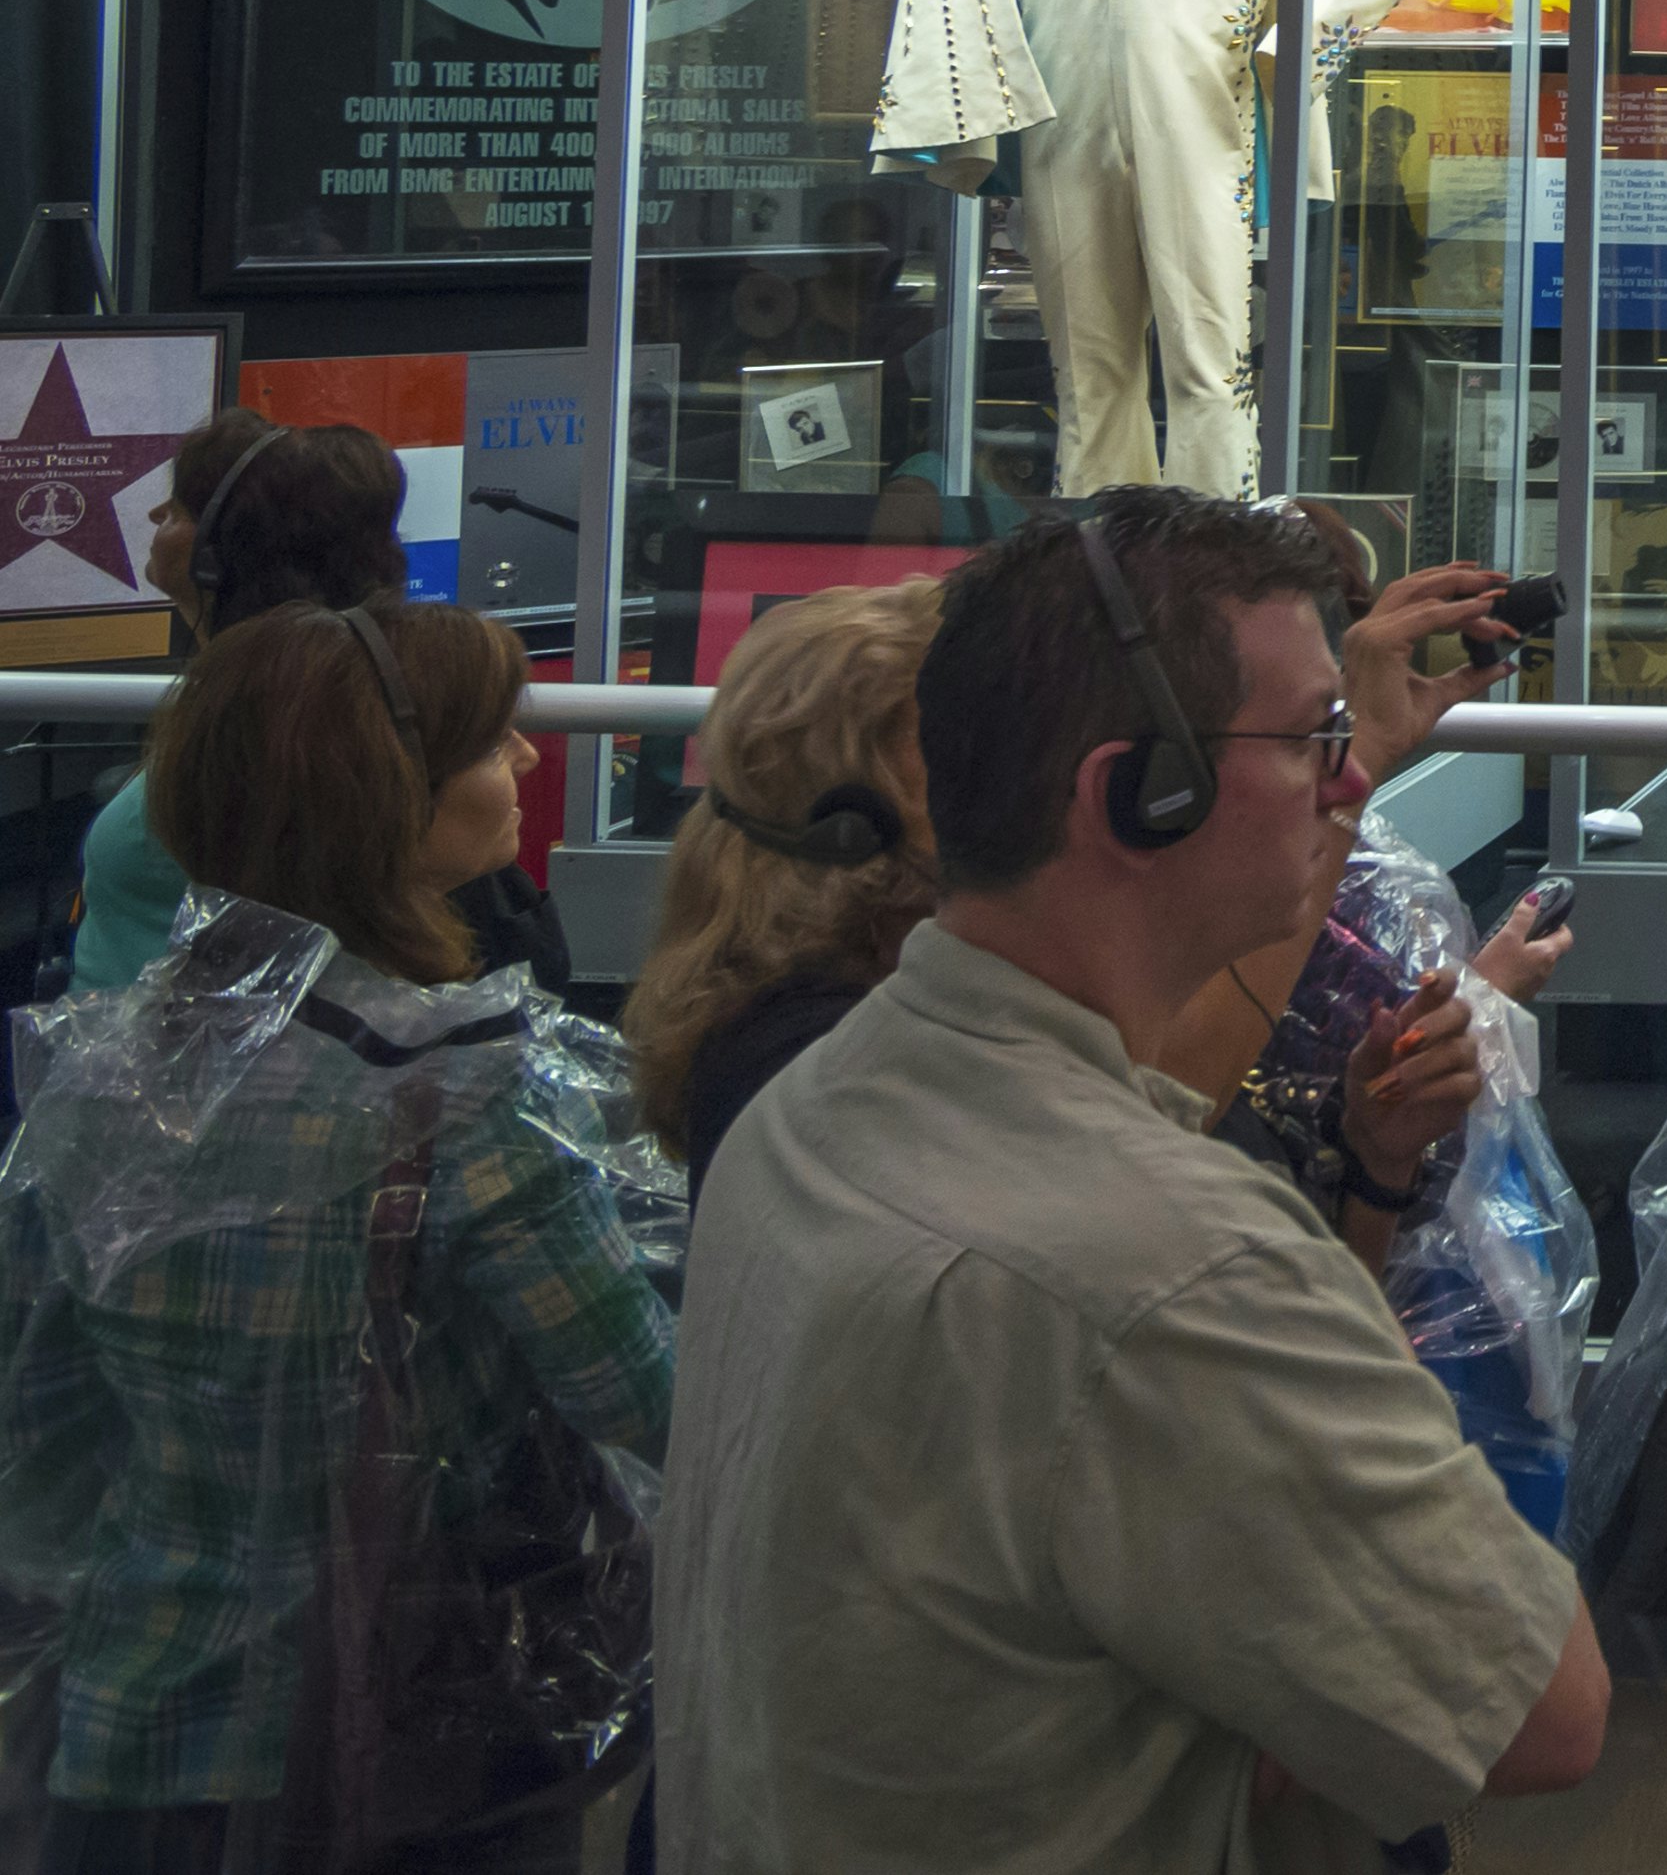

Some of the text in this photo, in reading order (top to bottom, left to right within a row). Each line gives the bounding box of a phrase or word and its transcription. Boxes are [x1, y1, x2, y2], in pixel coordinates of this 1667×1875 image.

[392, 61, 421, 87] TO
[433, 62, 474, 88] THE
[484, 62, 562, 88] ESTATE
[573, 63, 600, 88] OF
[678, 65, 768, 89] PRESLEY
[344, 98, 553, 122] COMMEMORATING
[743, 99, 807, 122] SALES
[359, 132, 790, 157] OF MORE THAN ALBUMS
[1544, 134, 1559, 142] The
[321, 167, 817, 194] FROM BMG INTERNATIONAL
[484, 202, 569, 227] AUGUST
[507, 397, 577, 413] ALWAYS
